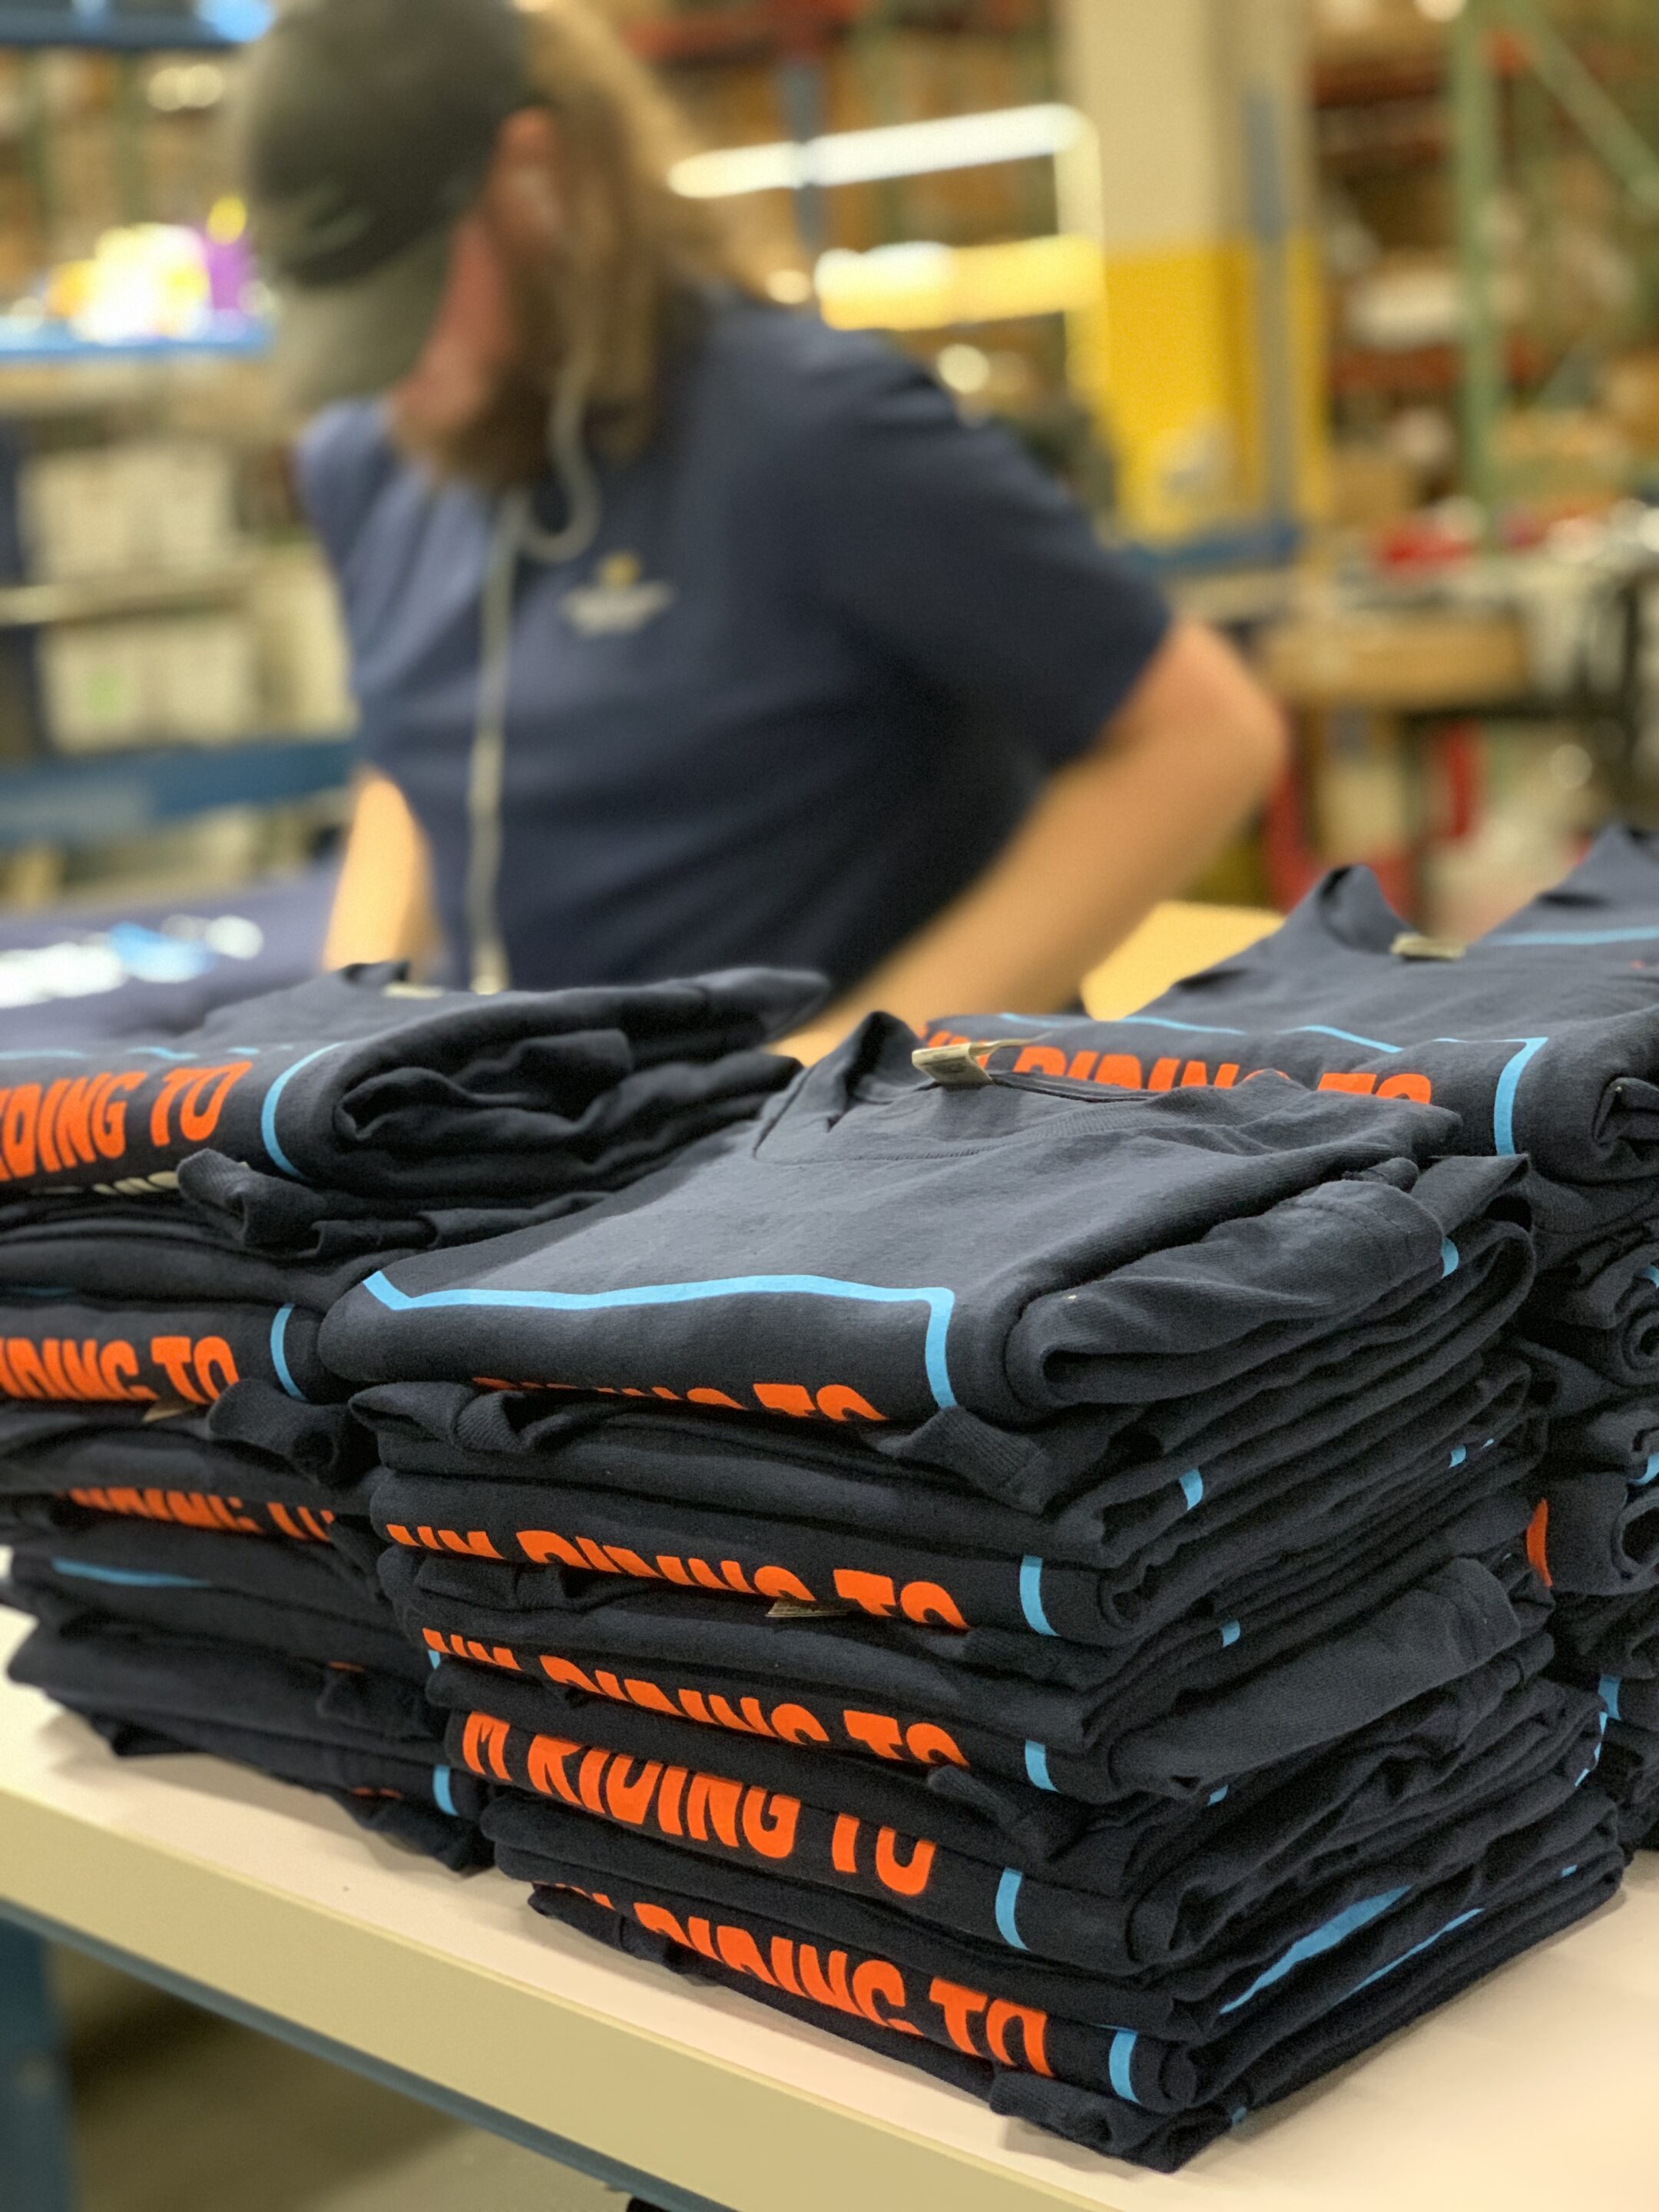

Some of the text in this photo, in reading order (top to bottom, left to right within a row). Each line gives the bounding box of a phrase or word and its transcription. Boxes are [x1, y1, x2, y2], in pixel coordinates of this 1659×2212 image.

[150, 1061, 253, 1147] TO
[151, 1335, 240, 1405] TO
[928, 1977, 1053, 2077] TO
